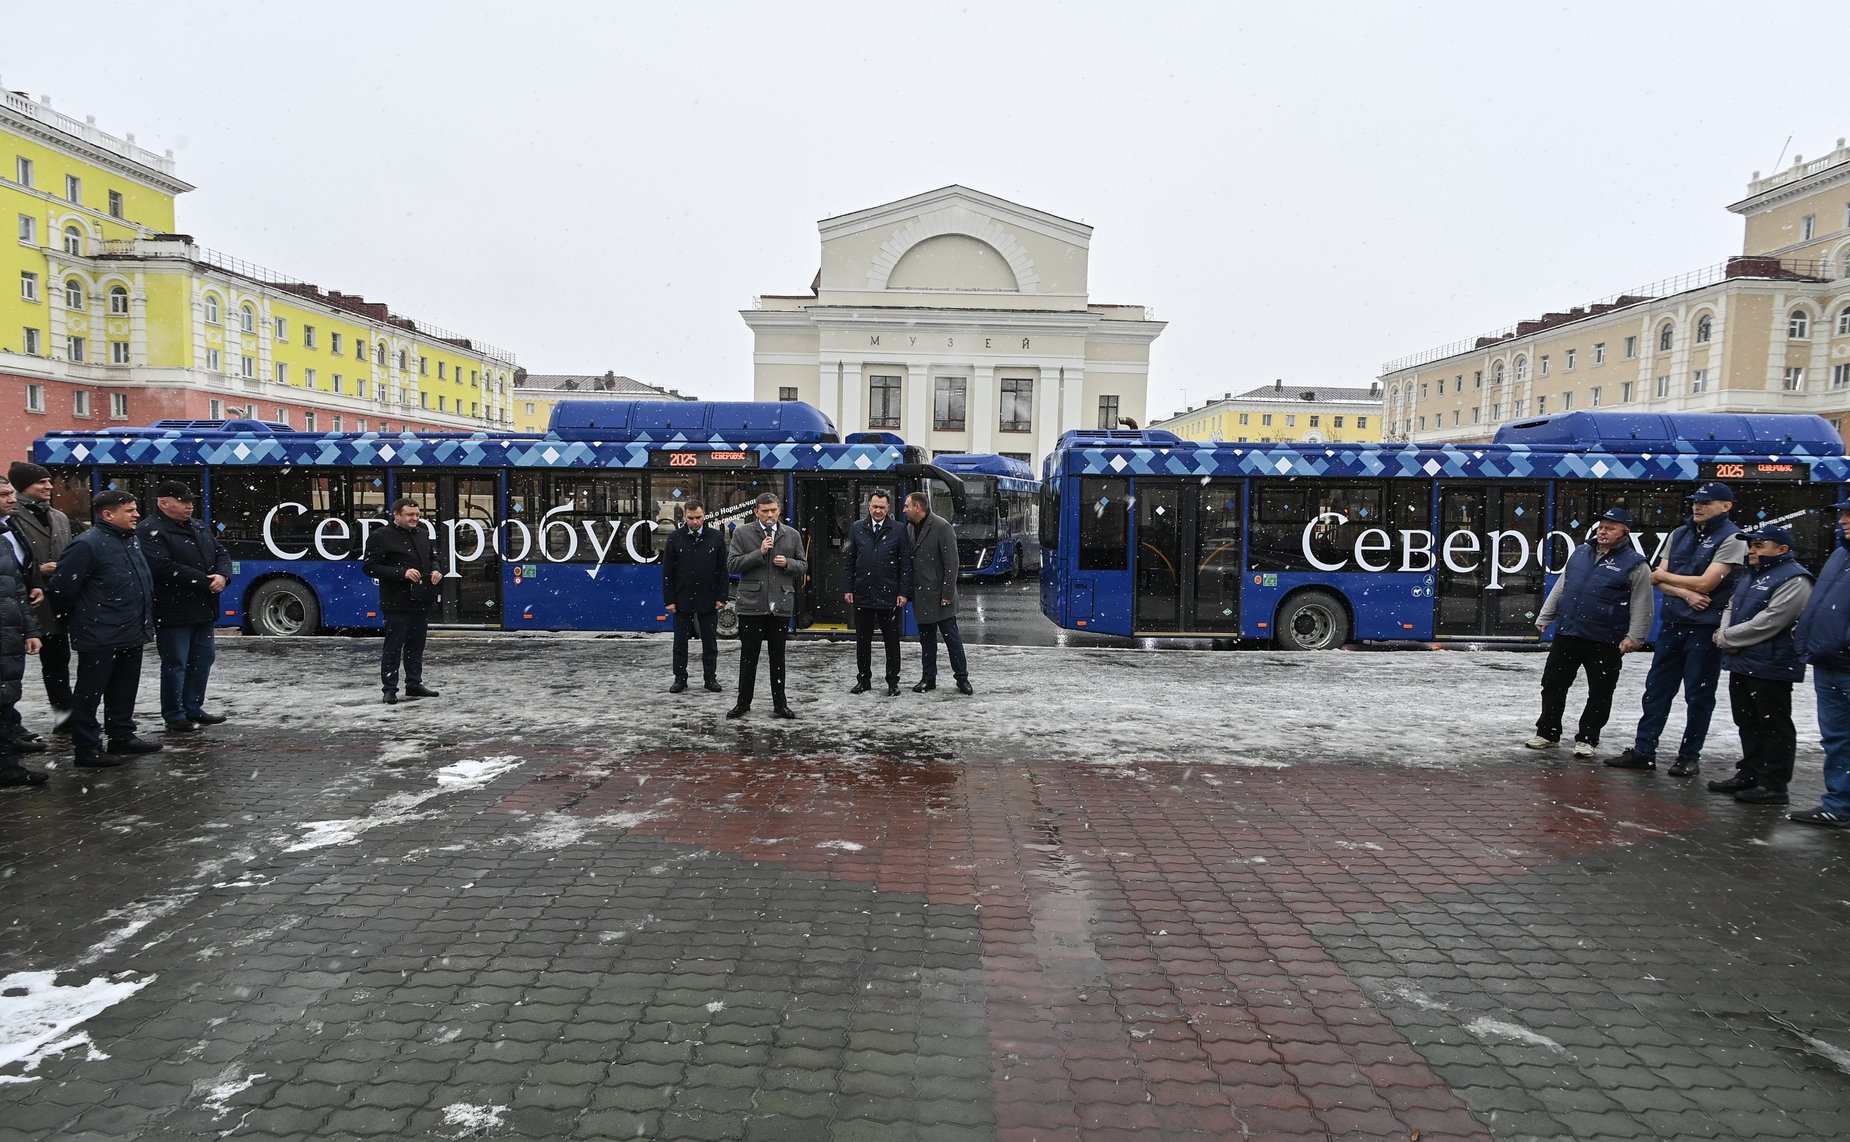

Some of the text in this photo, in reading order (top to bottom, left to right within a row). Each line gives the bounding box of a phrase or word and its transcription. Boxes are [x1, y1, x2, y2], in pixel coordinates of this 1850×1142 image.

[870, 335, 1030, 350] МУЗЕЙ
[670, 452, 746, 466] 2025 СЕВЕРОБУС
[1716, 464, 1745, 478] 2025
